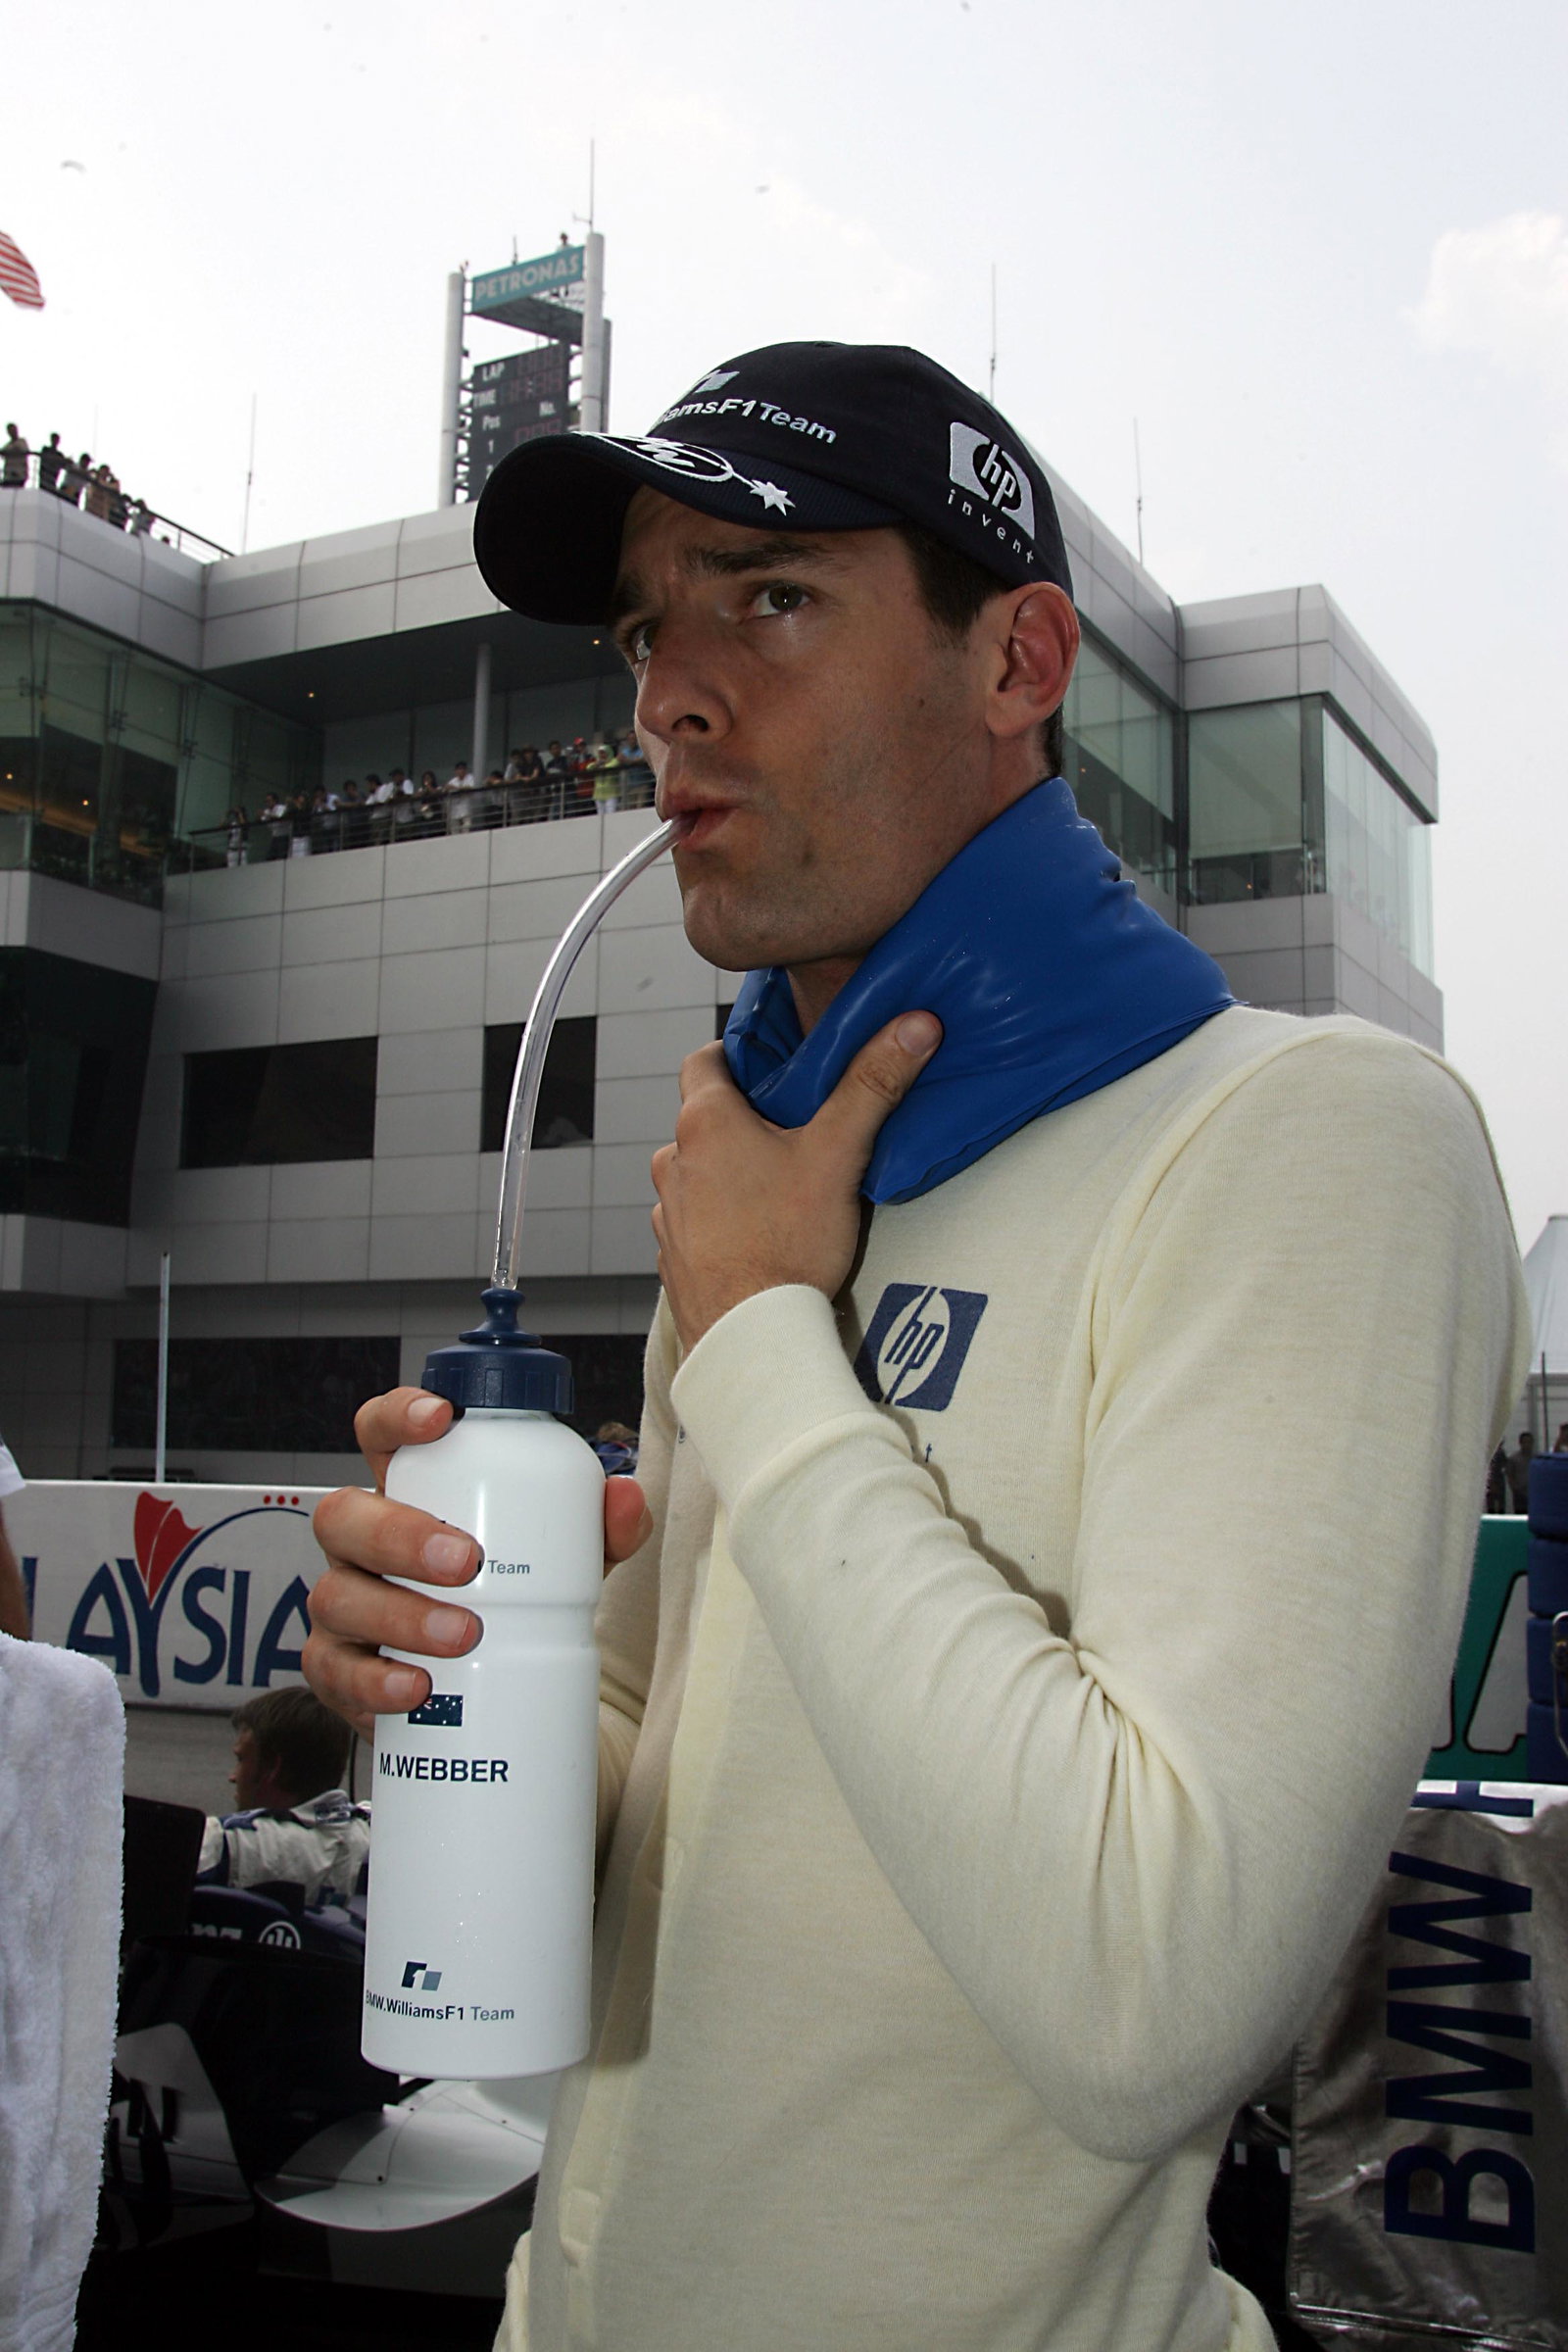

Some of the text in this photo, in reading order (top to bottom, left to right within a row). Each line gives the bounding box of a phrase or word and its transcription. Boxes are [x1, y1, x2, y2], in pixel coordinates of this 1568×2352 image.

[475, 254, 580, 302] PETRONAS
[482, 362, 505, 381] LAP
[948, 489, 1035, 564] invent
[488, 1560, 530, 1575] Team
[379, 1752, 509, 1783] M.WEBBER
[470, 2006, 514, 2022] Team
[1384, 1851, 1536, 2254] BMW
